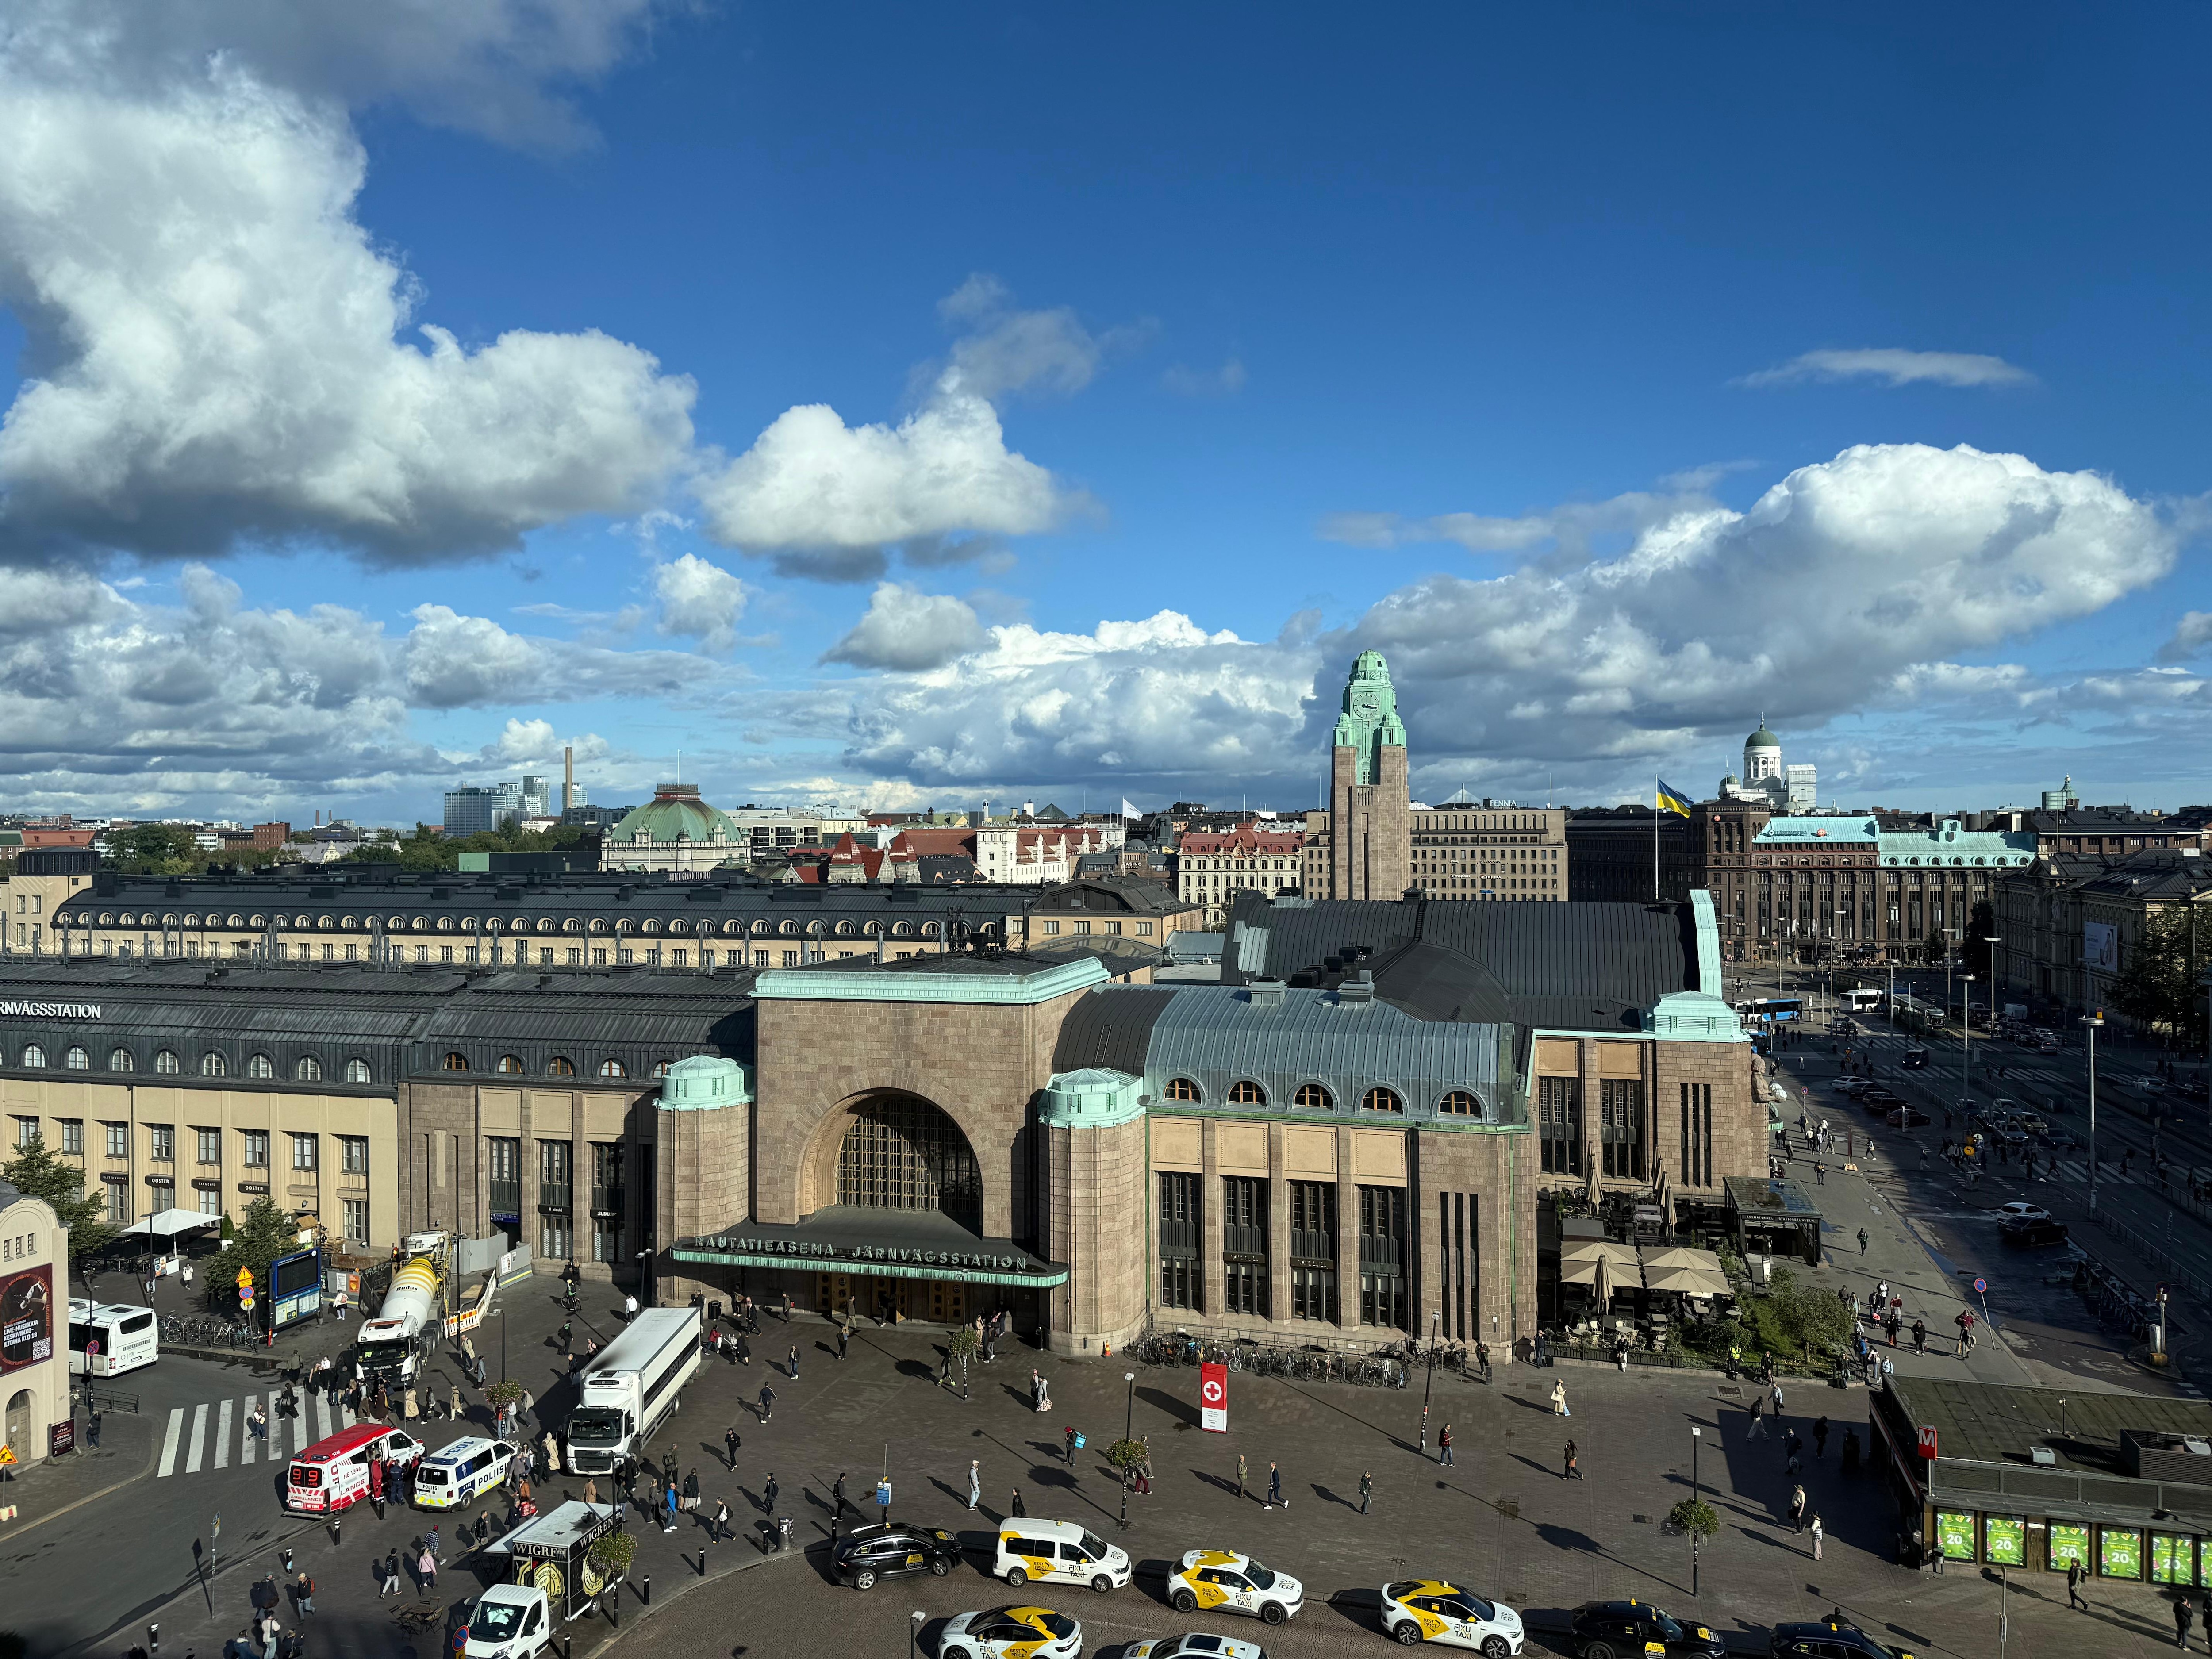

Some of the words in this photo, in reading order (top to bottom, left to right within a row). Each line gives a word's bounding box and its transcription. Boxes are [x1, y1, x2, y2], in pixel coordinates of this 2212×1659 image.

[695, 1236, 834, 1256] RAUTATIEASEMA
[852, 1245, 1026, 1270] JÄRNVÄGSSTATION
[1919, 1428, 1935, 1448] M
[292, 1468, 301, 1480] 9
[308, 1470, 318, 1482] 9
[351, 1466, 361, 1476] 1394
[579, 1516, 613, 1548] WIGREN
[1237, 1599, 1252, 1608] TAXI
[1454, 1623, 1471, 1632] FIXU
[1455, 1631, 1471, 1640] TAXI
